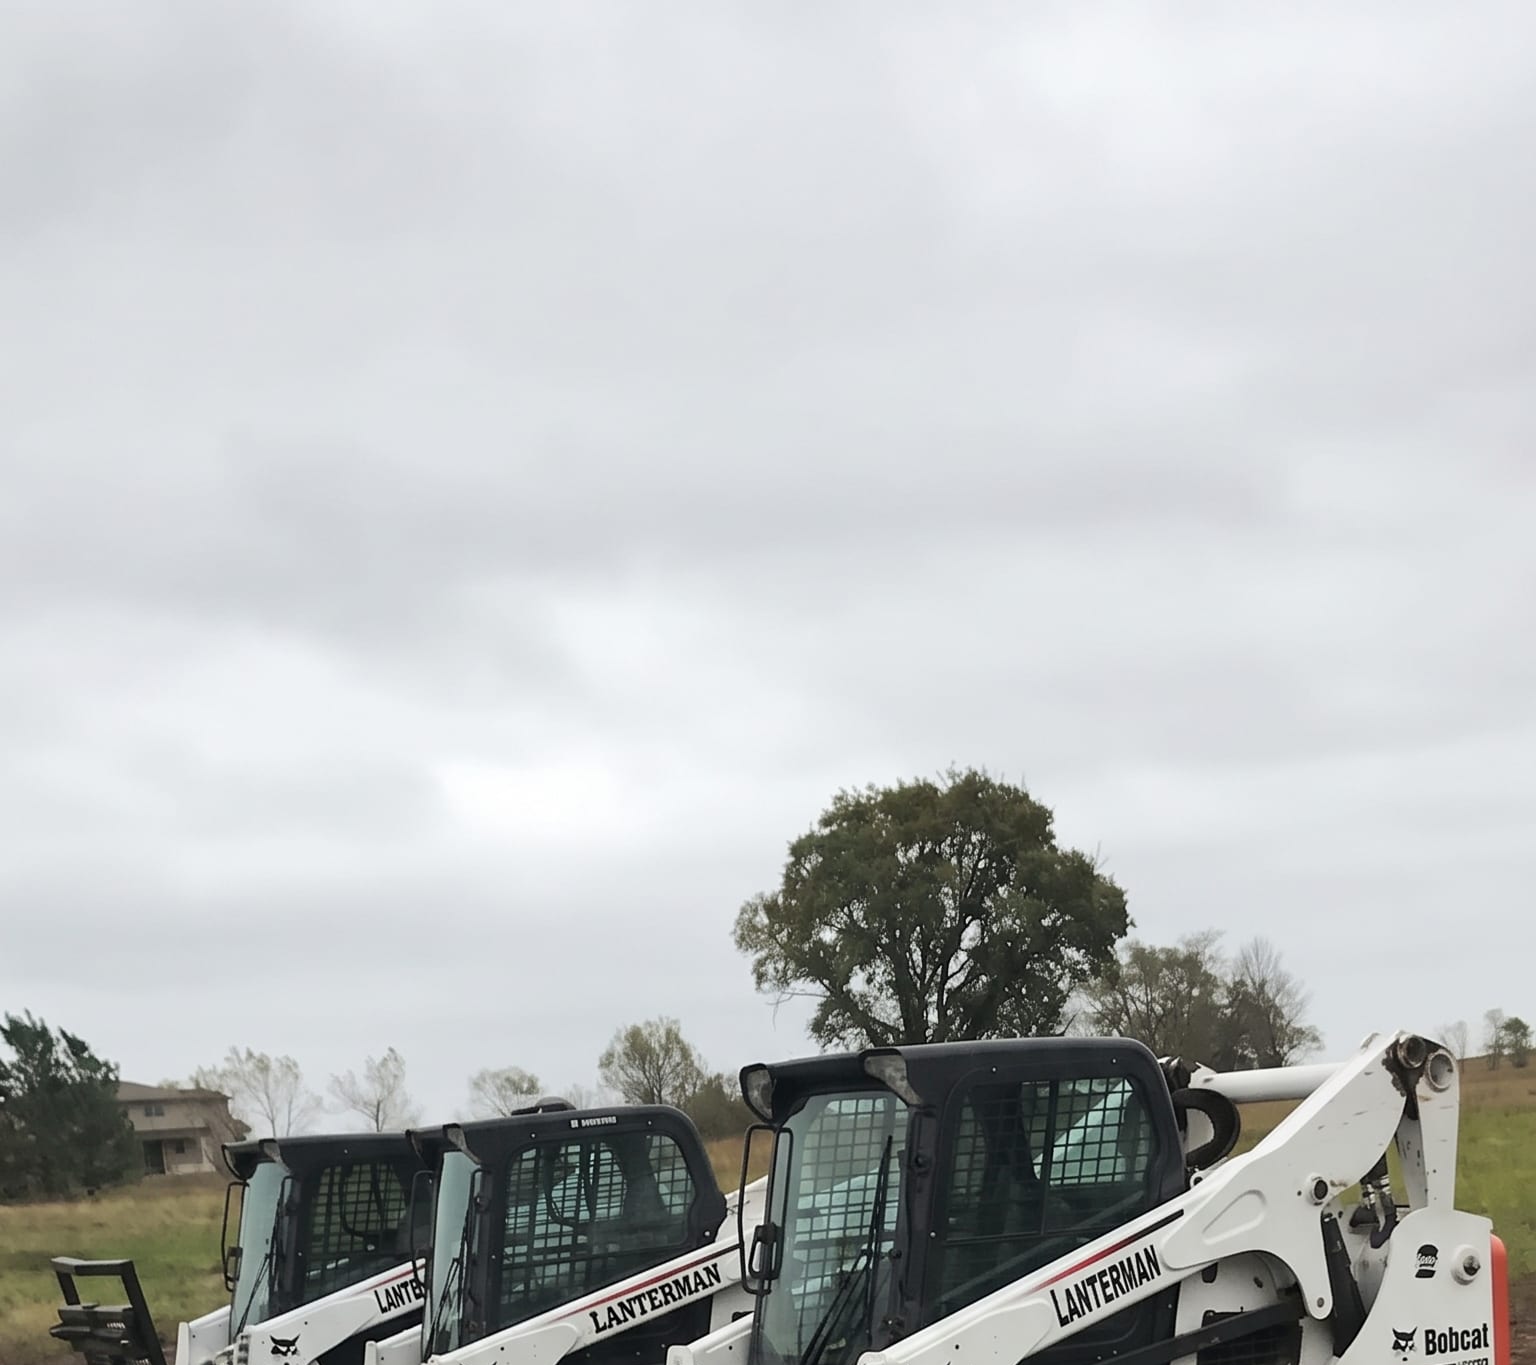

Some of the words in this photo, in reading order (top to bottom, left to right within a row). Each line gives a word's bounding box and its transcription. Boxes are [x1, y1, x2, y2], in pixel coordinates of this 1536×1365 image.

[589, 1262, 722, 1334] LANTERMAN
[1049, 1244, 1161, 1328] LANTERMAN
[1424, 1322, 1489, 1356] Bobcat
